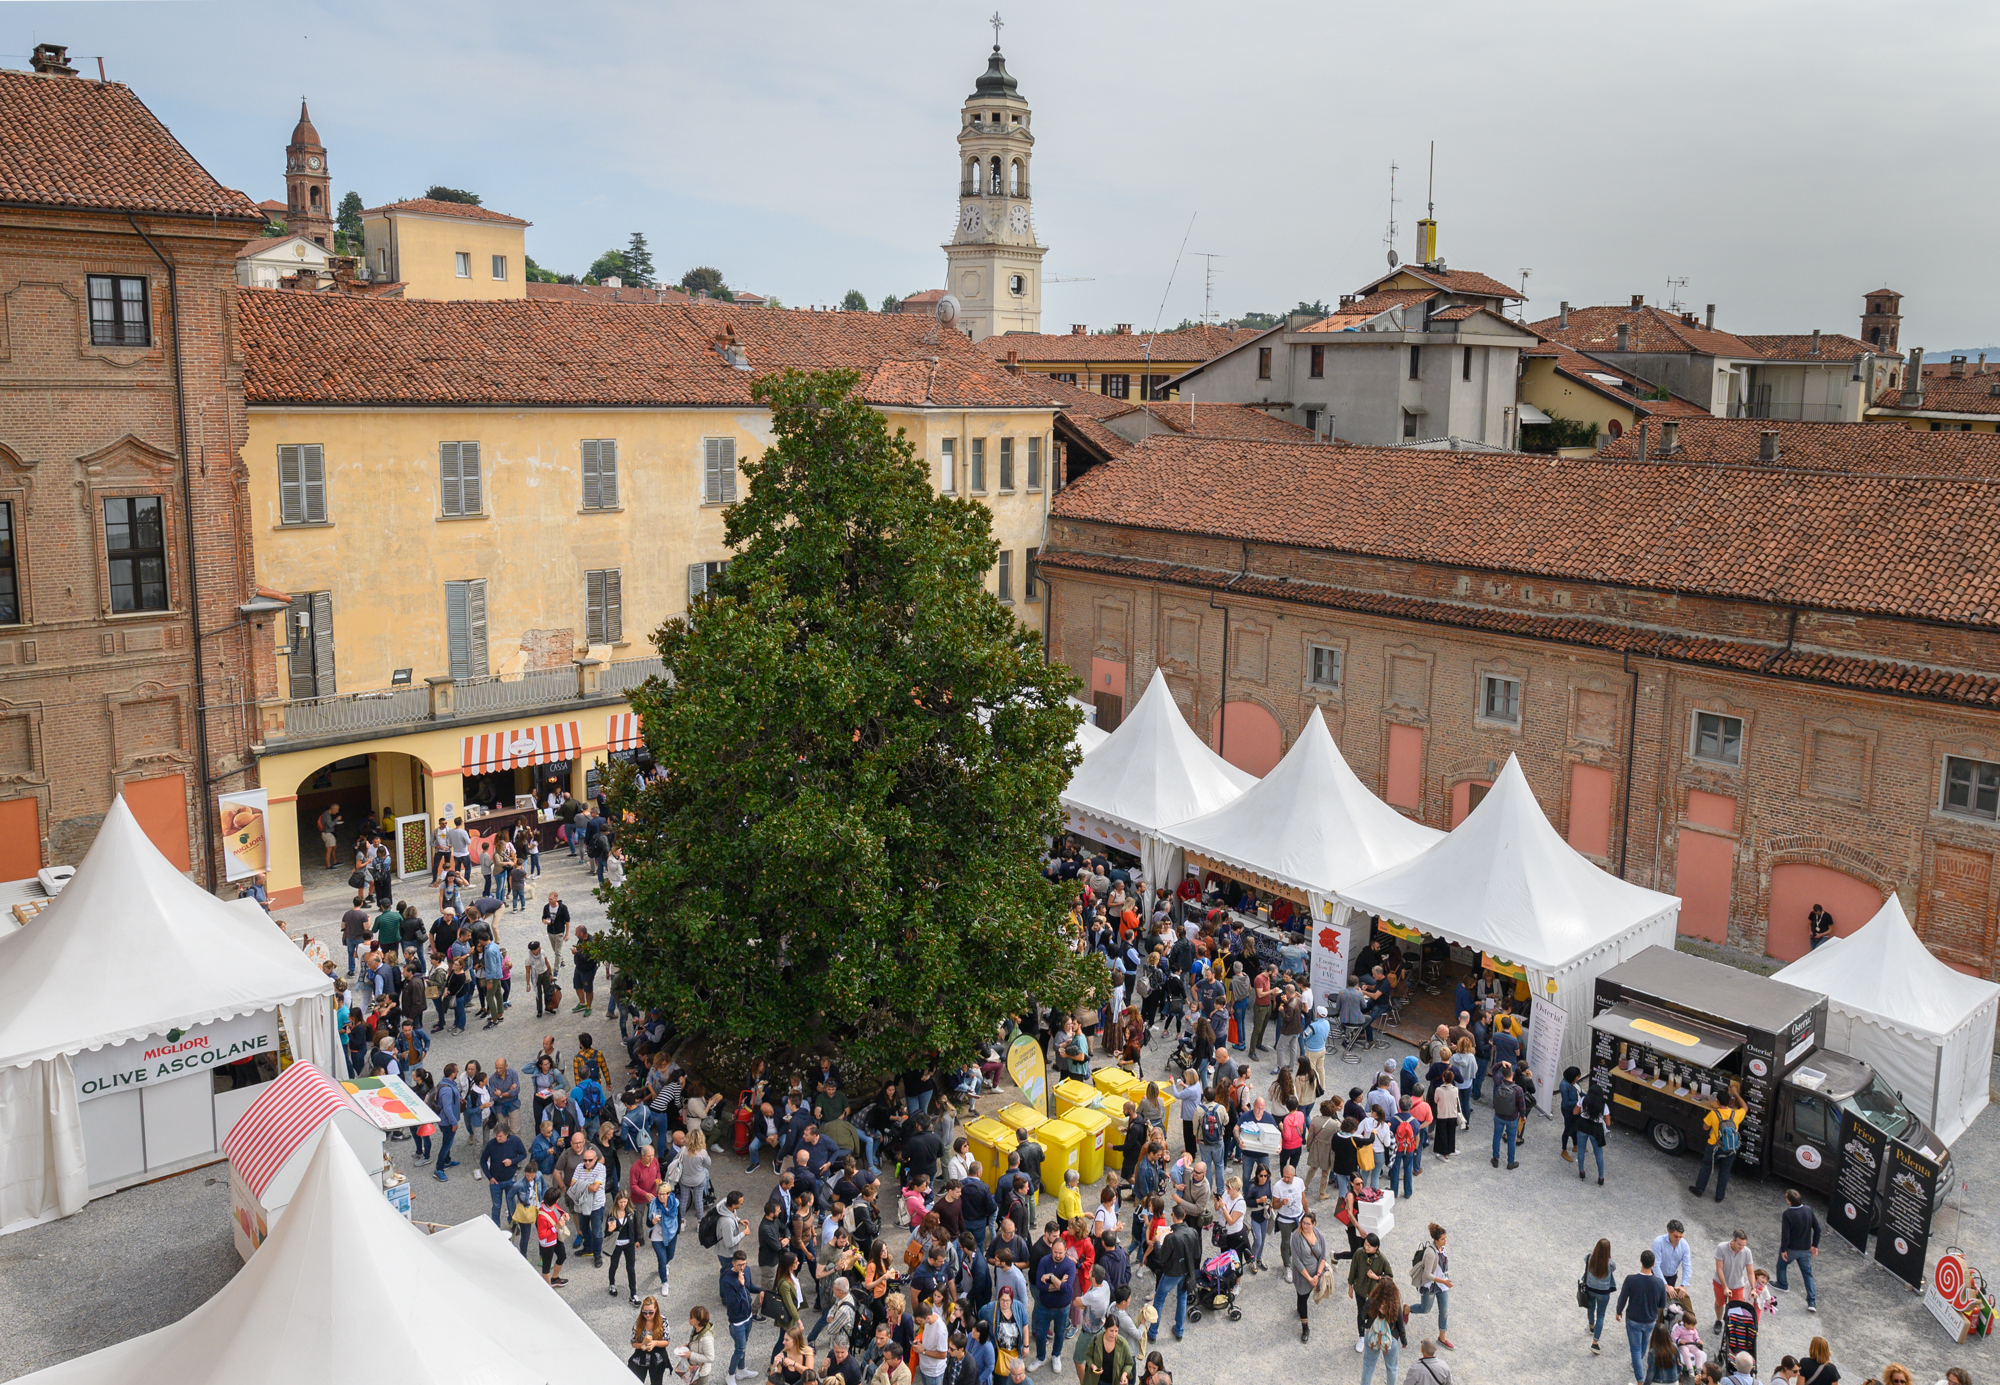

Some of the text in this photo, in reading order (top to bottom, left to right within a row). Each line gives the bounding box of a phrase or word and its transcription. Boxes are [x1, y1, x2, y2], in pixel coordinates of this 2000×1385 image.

[549, 761, 568, 772] CASSA
[233, 834, 264, 856] MIGLIORI
[1535, 1001, 1563, 1024] Osteria!
[143, 1035, 211, 1062] MIGLIORI
[1746, 1043, 1773, 1057] Osteria!
[81, 1034, 269, 1094] OLIVE ASCOLANE
[1853, 1121, 1876, 1144] Frico
[1896, 1148, 1931, 1178] Polenta
[1929, 1289, 1963, 1329] Slow Food
